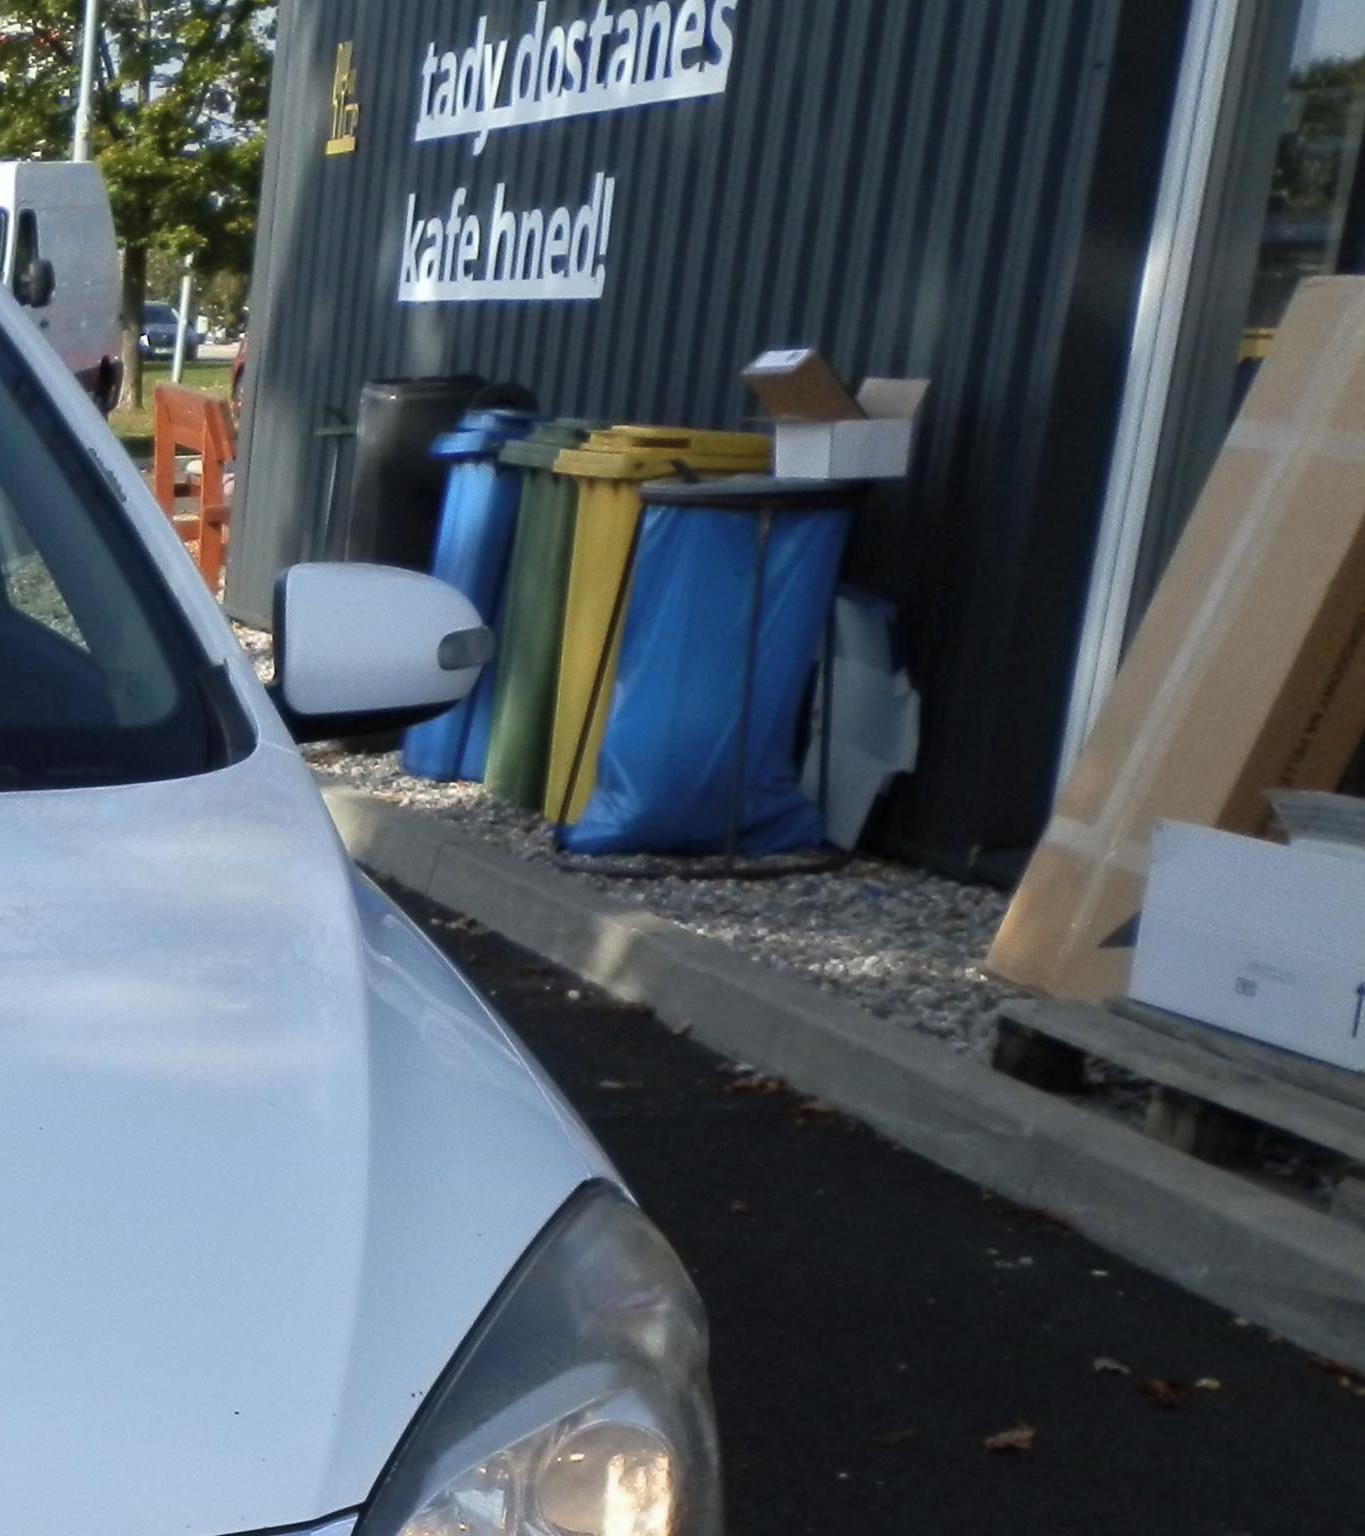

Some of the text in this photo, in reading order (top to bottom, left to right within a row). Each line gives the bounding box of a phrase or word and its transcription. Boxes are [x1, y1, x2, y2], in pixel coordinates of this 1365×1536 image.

[418, 15, 508, 155] tady
[400, 172, 615, 291] kafe hned!
